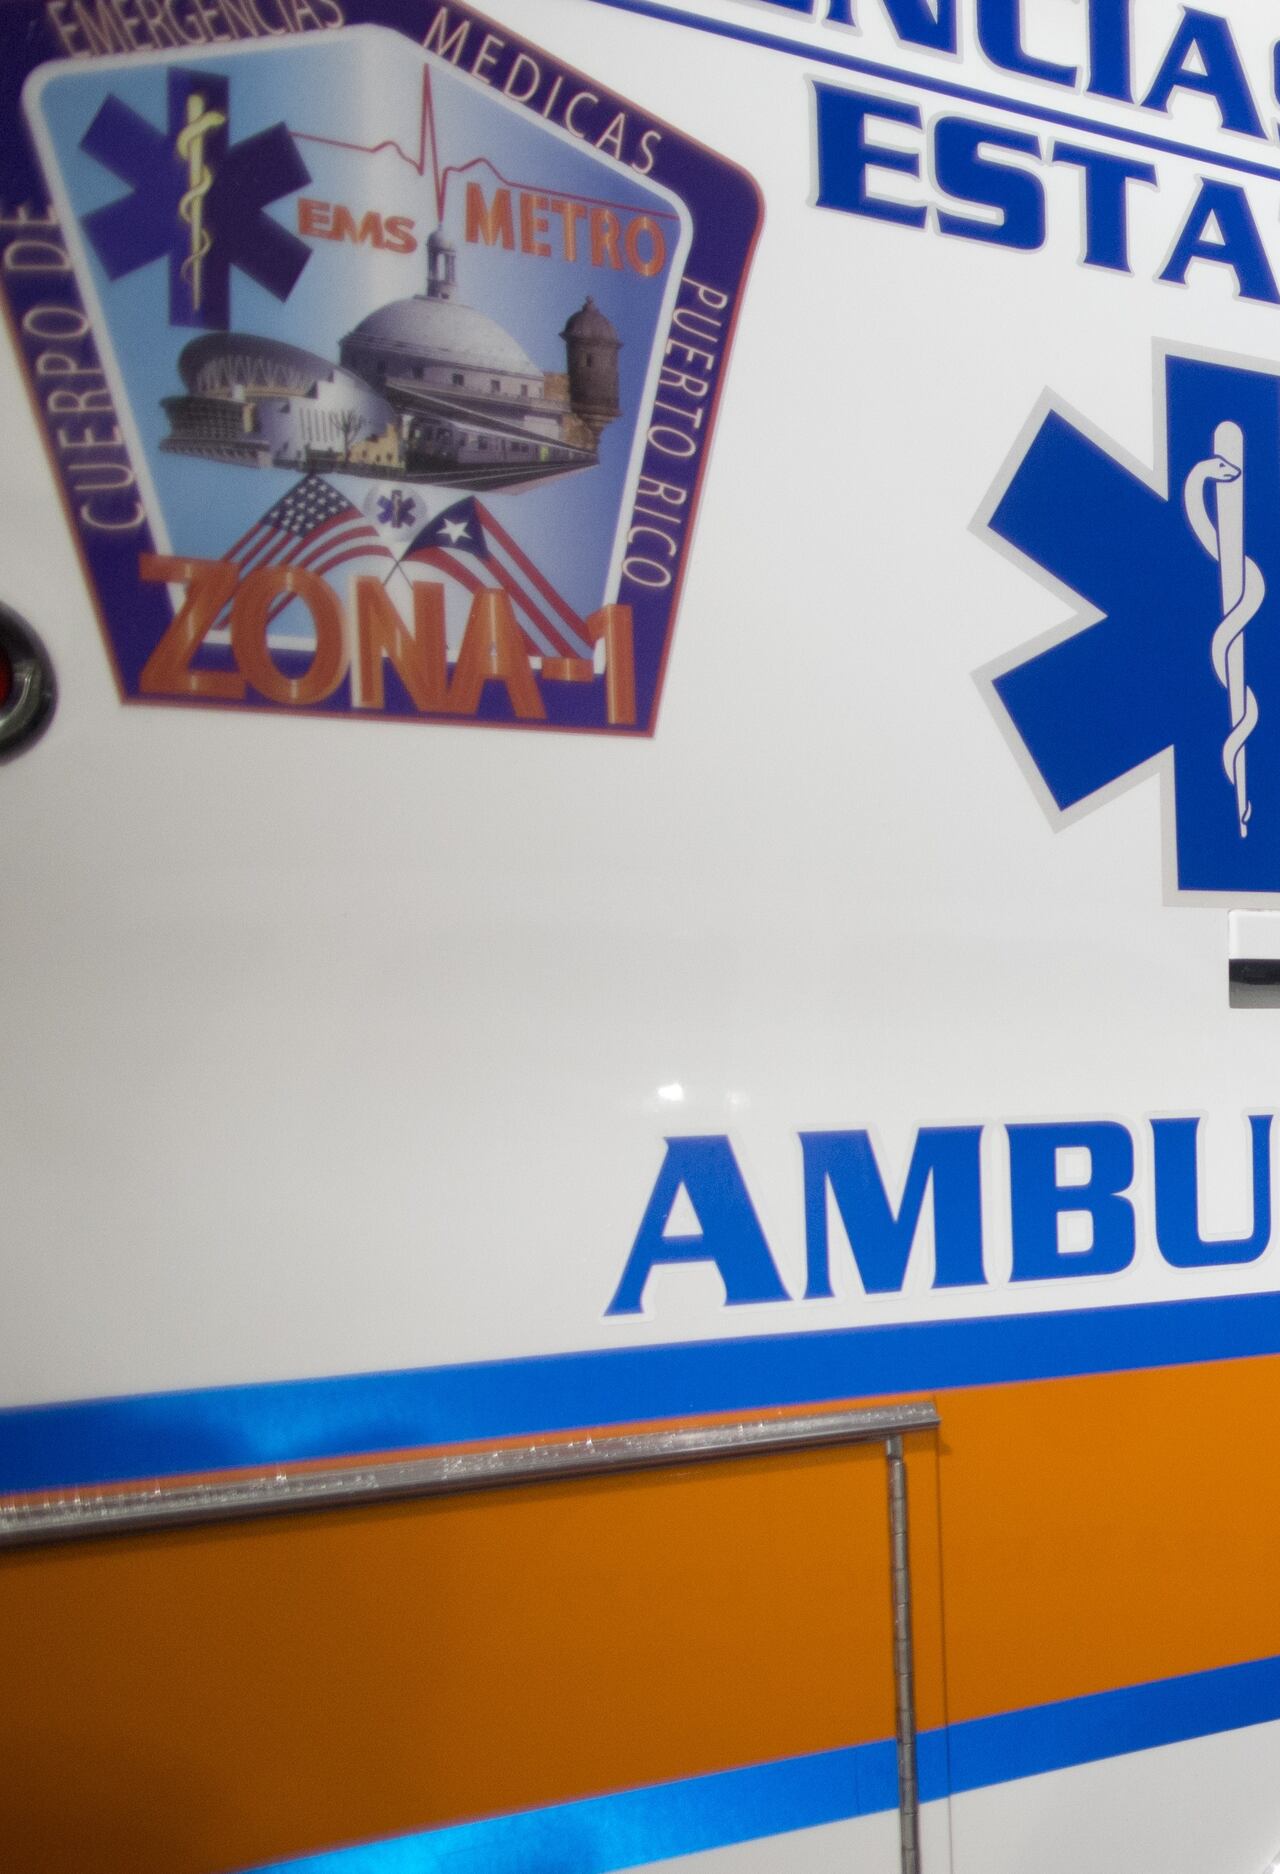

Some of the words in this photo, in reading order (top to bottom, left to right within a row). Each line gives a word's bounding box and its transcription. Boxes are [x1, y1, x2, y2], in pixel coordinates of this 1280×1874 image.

[422, 8, 662, 176] MEDICAS
[0, 203, 74, 273] DE
[300, 200, 417, 254] EMS
[464, 181, 666, 279] METRO
[22, 305, 148, 530] CUERPO
[647, 275, 729, 459] PUERTO
[621, 473, 688, 588] RICO
[138, 552, 637, 726] ZONA-1
